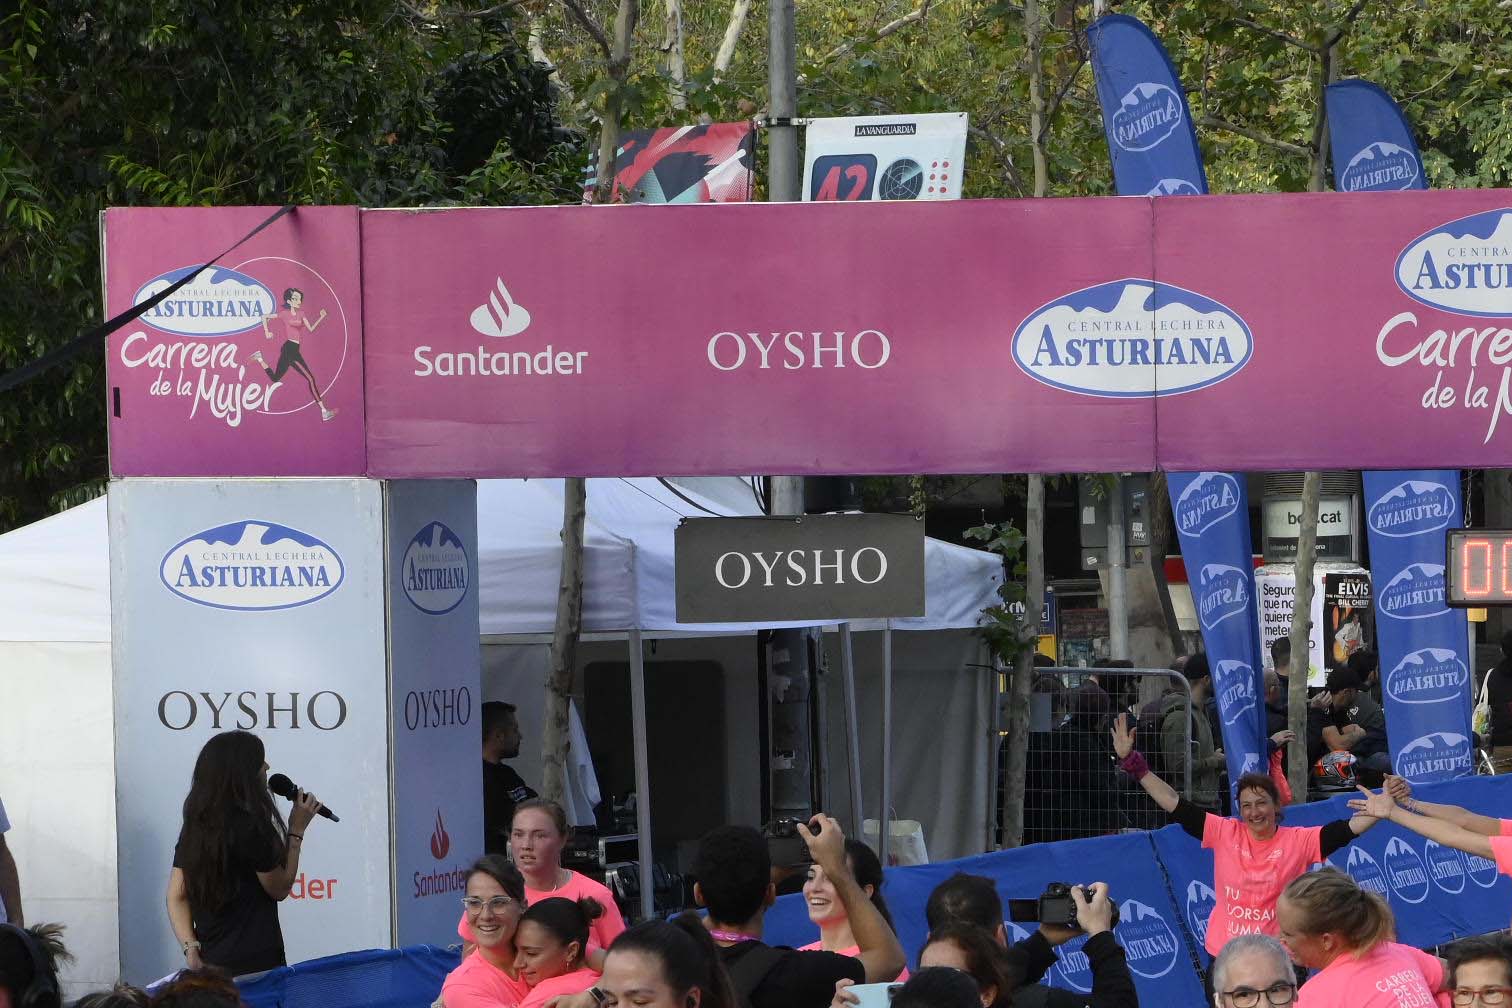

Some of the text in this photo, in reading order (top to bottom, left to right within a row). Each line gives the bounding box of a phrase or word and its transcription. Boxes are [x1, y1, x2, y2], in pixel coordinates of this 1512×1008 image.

[143, 290, 264, 318] ASTURIANA
[1068, 319, 1226, 332] CENTRAL LECHERA
[121, 331, 239, 369] Carrera
[414, 345, 589, 377] Santander
[706, 329, 891, 371] OYSHO
[1030, 324, 1235, 368] ASTURIANA
[149, 366, 283, 427] de la Mujer
[1421, 370, 1456, 409] de
[1464, 366, 1489, 409] la
[175, 554, 331, 588] ASTURIANA
[202, 552, 325, 561] CENTRAL LECHERA
[714, 546, 888, 590] OYSHO
[407, 562, 466, 593] ASTURIANA
[1338, 582, 1369, 596] ELVIS
[1263, 601, 1281, 610] que
[1264, 612, 1293, 624] quiere
[157, 690, 348, 732] OYSHO
[404, 687, 472, 731] OYSHO
[1225, 886, 1240, 901] TU
[1393, 986, 1409, 998] DE
